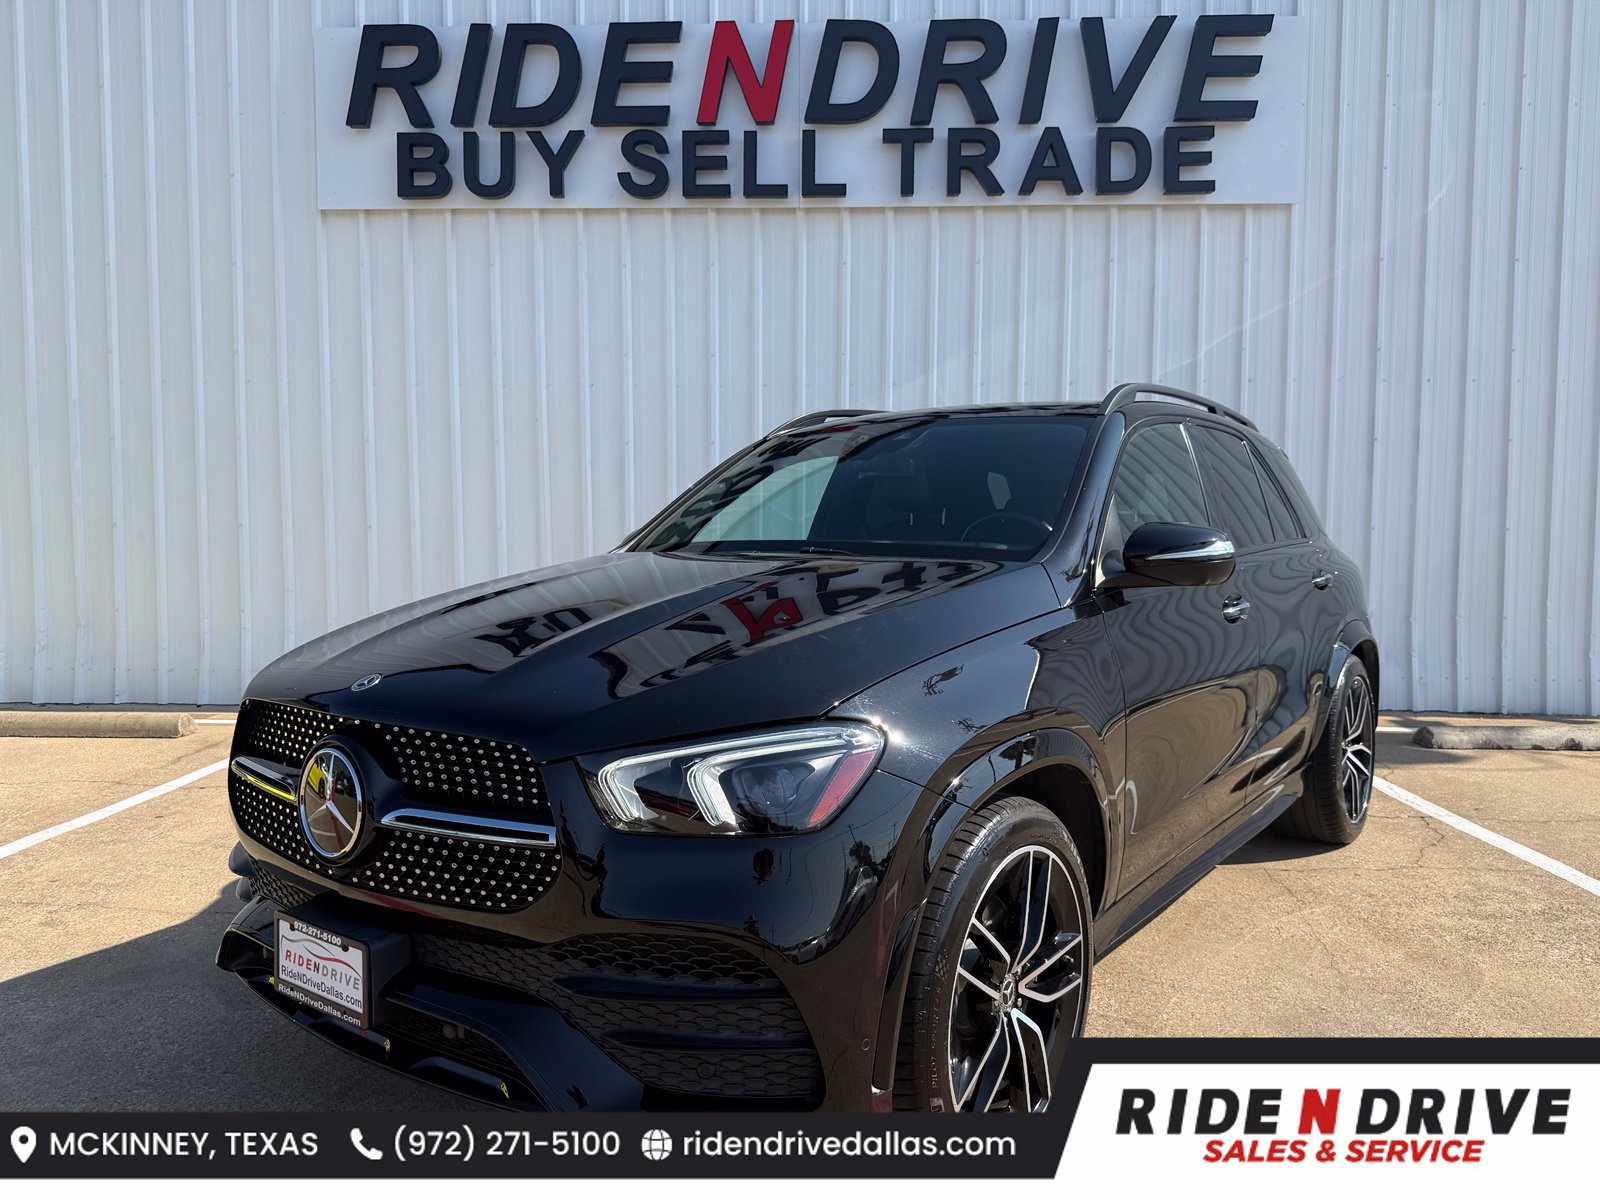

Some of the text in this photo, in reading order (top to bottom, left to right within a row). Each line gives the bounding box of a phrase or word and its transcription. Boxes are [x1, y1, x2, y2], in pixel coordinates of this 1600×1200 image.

[396, 125, 1216, 200] BUY SELL TRADE
[293, 921, 342, 945] 972-271-5100
[281, 964, 362, 1008] RideNDriveDallas.com
[284, 949, 361, 991] RIDENDRIVE
[278, 983, 361, 1026] RideNDriveDallas.com
